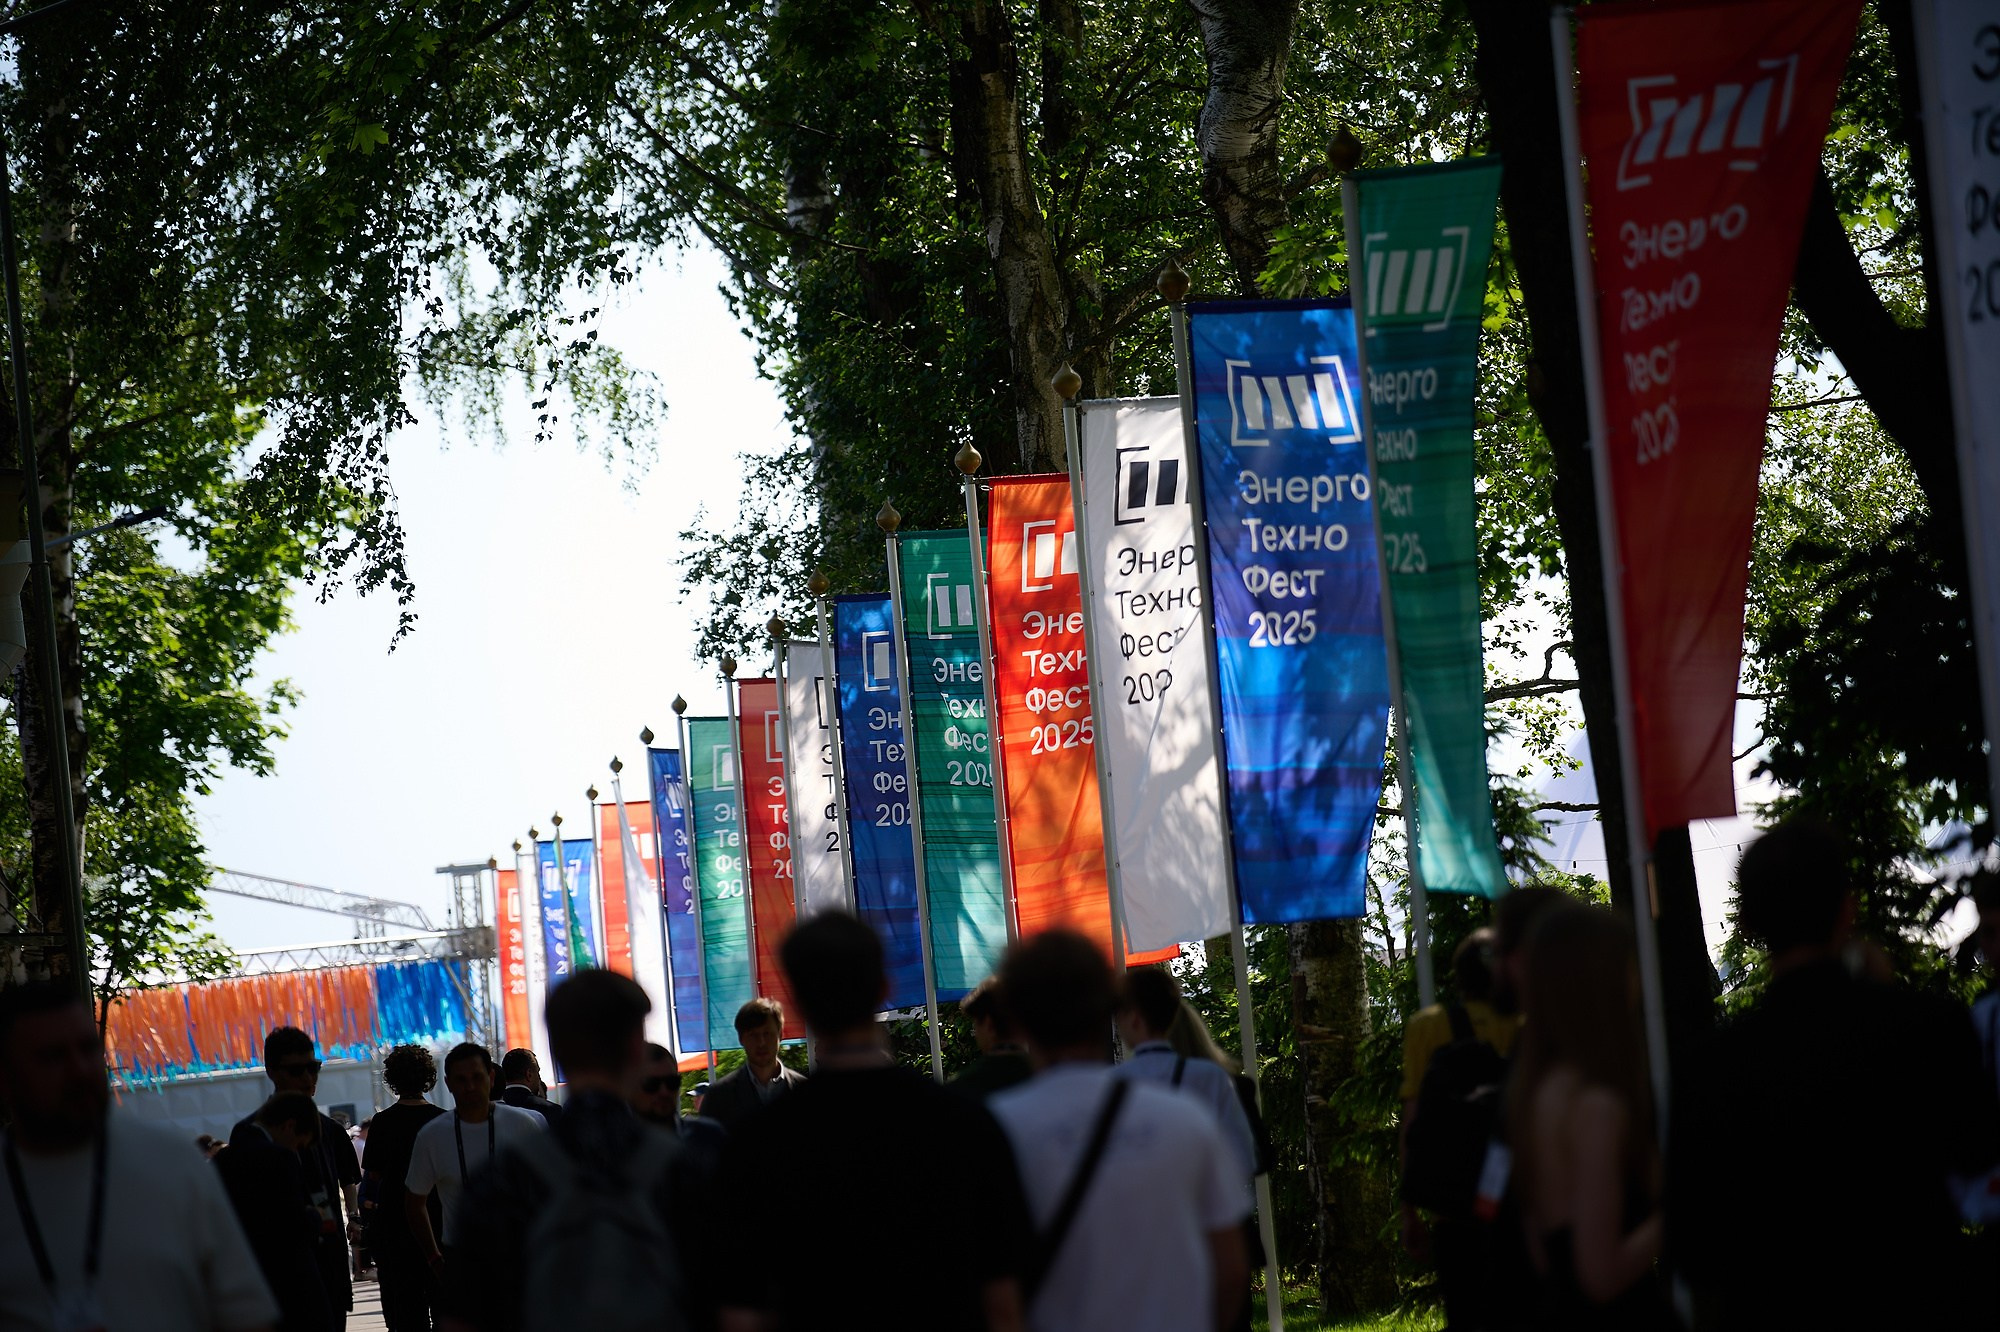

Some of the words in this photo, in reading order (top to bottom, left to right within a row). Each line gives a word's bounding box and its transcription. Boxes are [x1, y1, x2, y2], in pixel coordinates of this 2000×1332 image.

[1239, 469, 1371, 513] Энерго
[1241, 518, 1348, 553] Техно
[1117, 544, 1197, 576] Энер
[1241, 564, 1325, 599] Фест
[1115, 586, 1203, 619] Техно
[1022, 610, 1084, 640] Эне
[1248, 609, 1317, 648] 2025
[932, 657, 982, 683] Эне
[867, 706, 902, 731] Эн
[1030, 716, 1095, 756] 2025
[768, 775, 785, 797] Э
[873, 771, 906, 794] Фе
[826, 831, 840, 853] 2
[716, 879, 744, 900] 20
